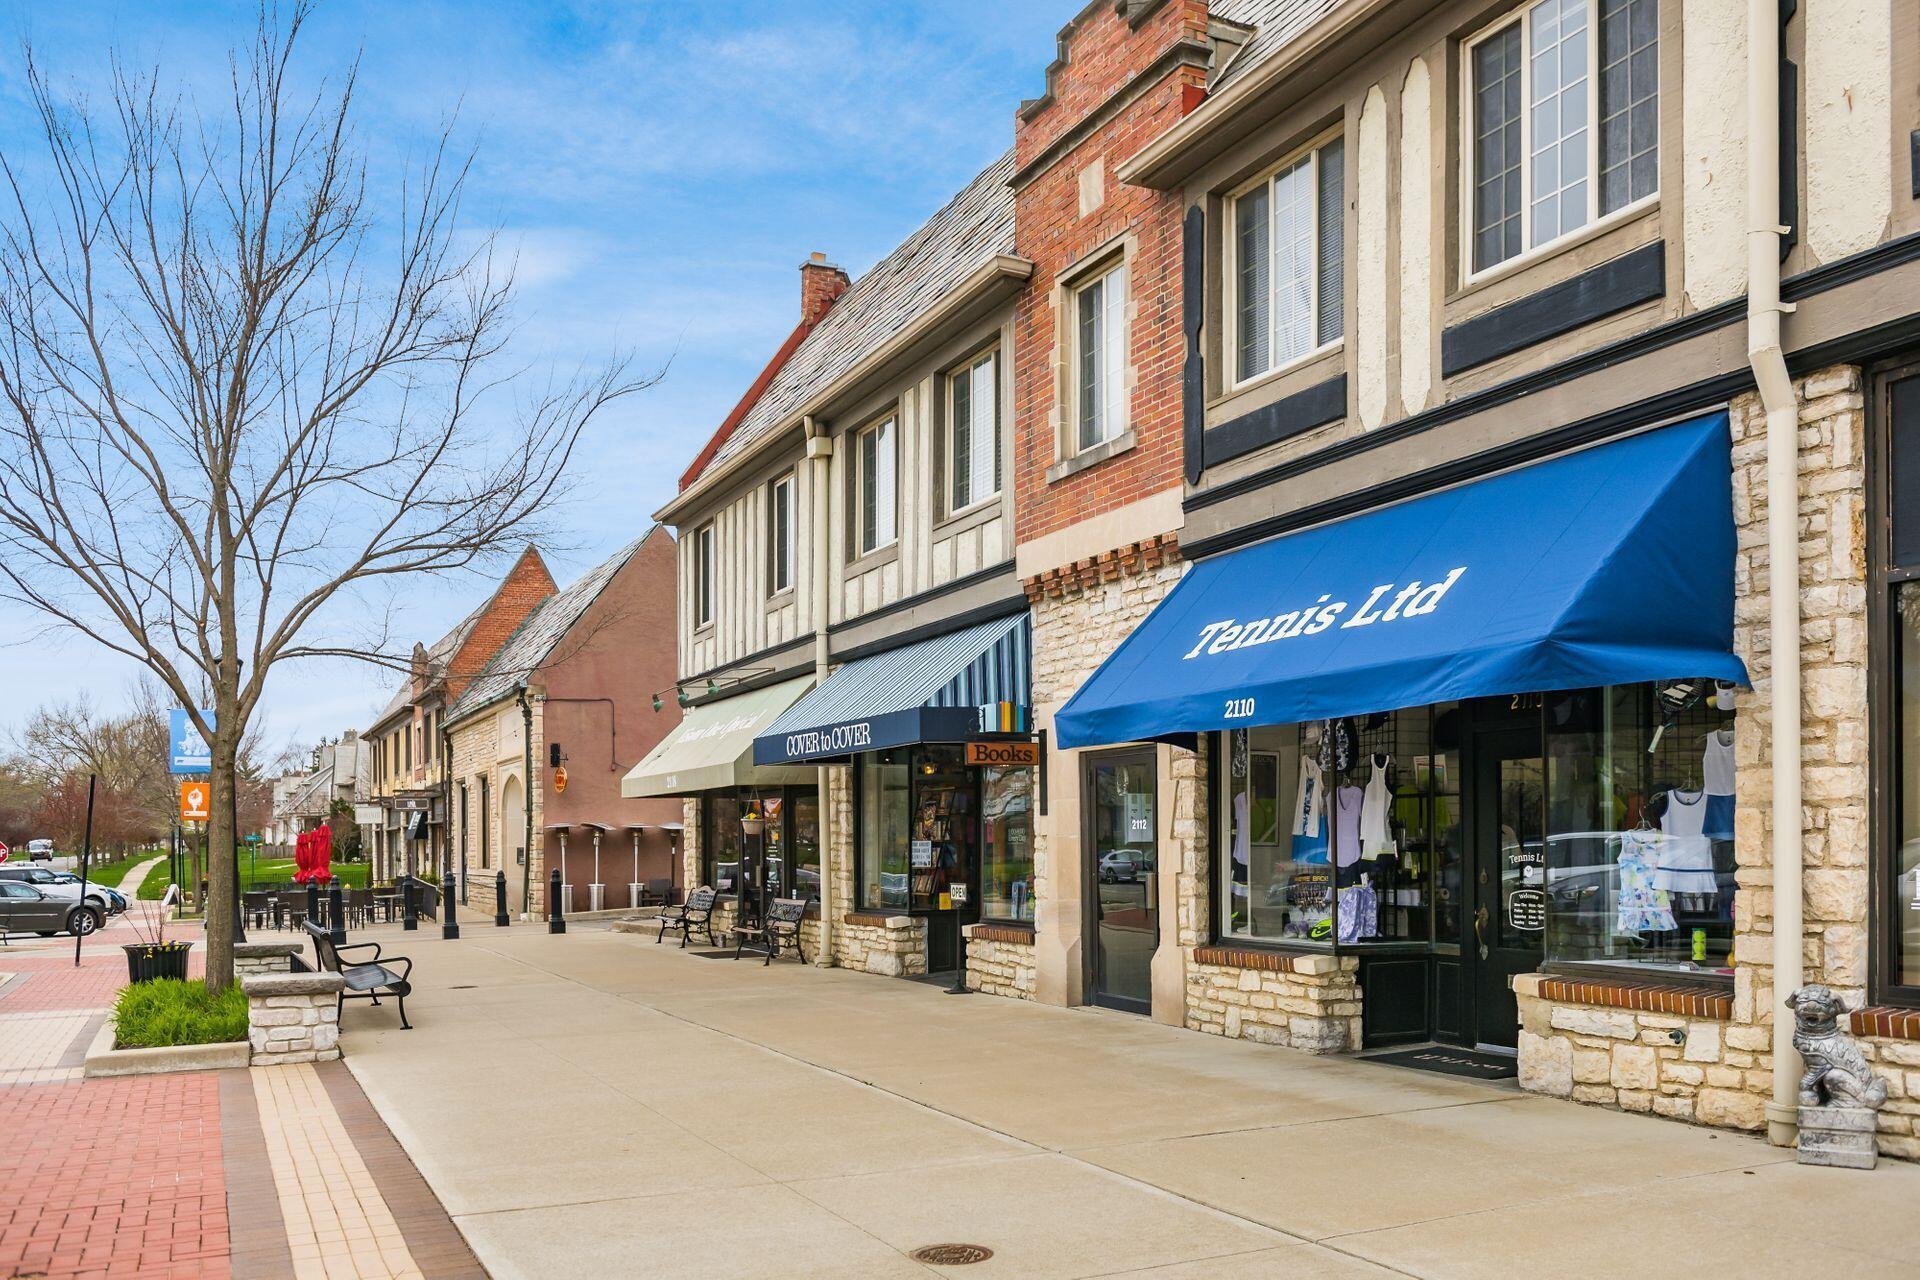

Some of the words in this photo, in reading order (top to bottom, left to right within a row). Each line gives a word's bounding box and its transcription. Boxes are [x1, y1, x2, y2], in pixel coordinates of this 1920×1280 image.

[1182, 594, 1348, 660] Tennis
[1340, 566, 1467, 629] Ltd
[1223, 697, 1255, 719] 2110
[786, 732, 820, 756] COVER
[820, 731, 831, 751] to
[832, 722, 871, 749] COVER
[974, 745, 1033, 762] Books
[1131, 819, 1147, 830] 2112
[1509, 852, 1536, 864] Tennis
[951, 886, 966, 898] OPEN
